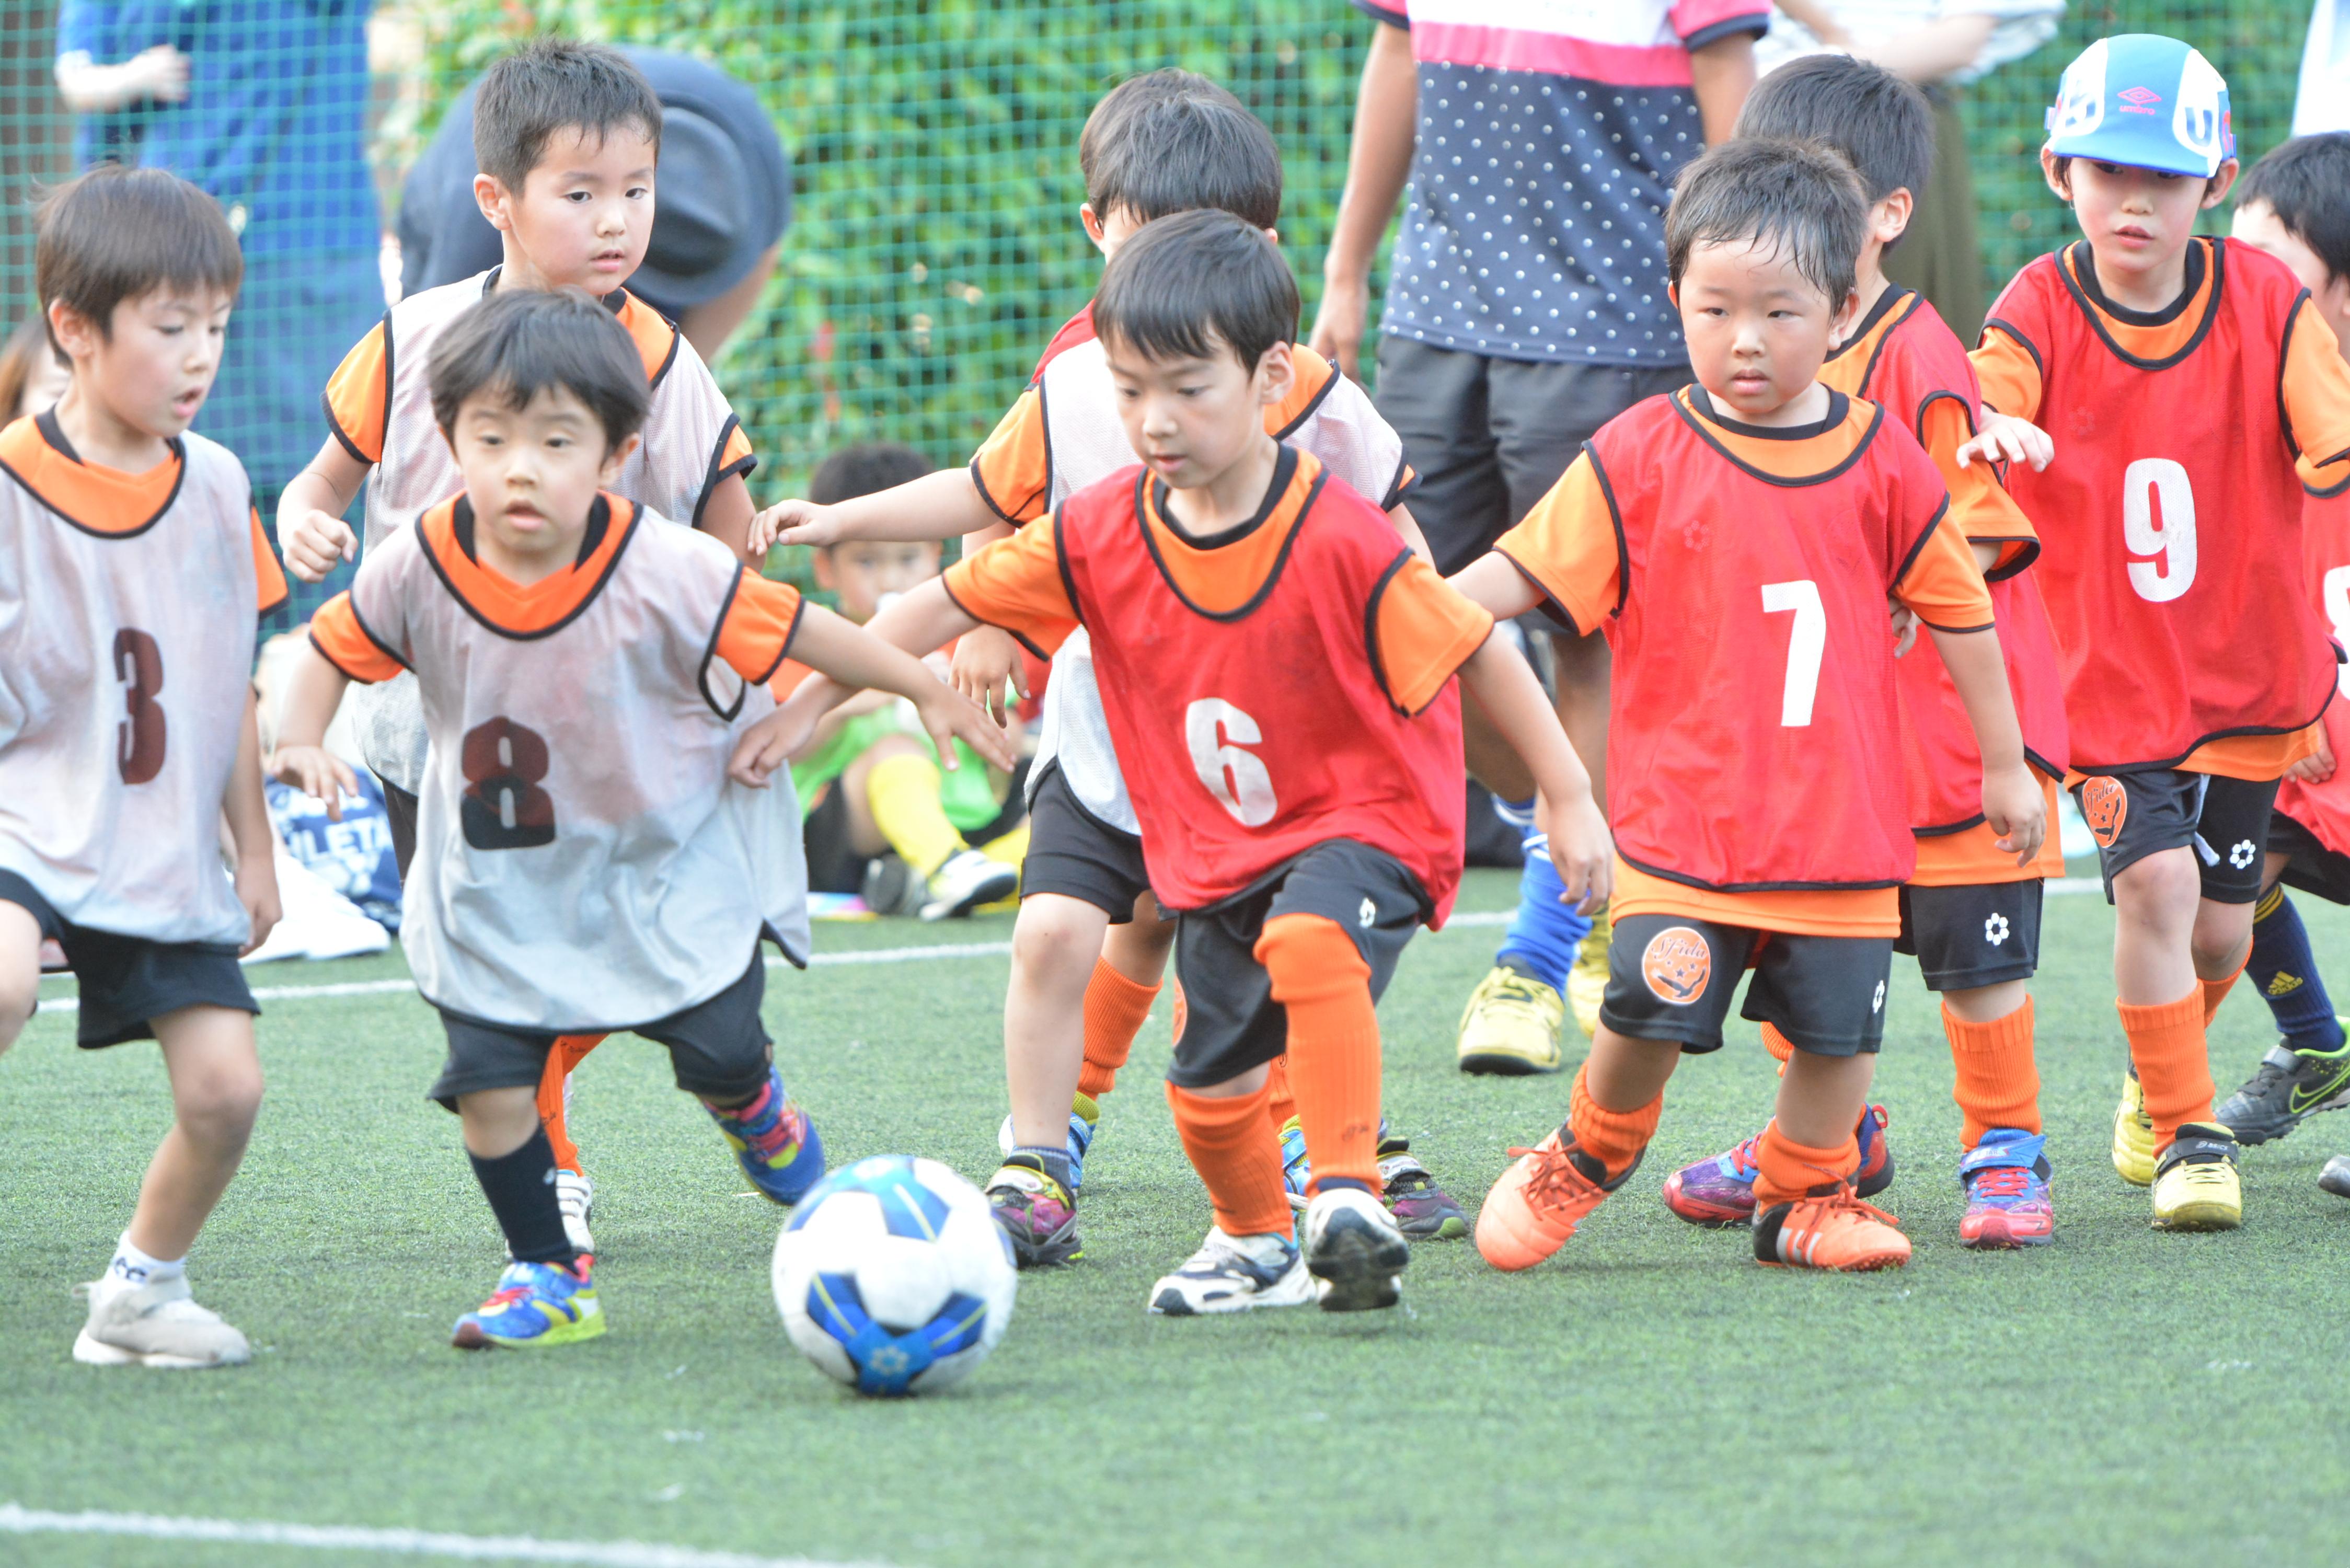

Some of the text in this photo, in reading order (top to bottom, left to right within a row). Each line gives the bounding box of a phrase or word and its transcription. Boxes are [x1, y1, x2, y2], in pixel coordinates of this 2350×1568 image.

[2119, 104, 2156, 115] umbro
[2124, 458, 2197, 602] 9
[113, 627, 166, 785] 3
[1761, 580, 1826, 727] 7
[461, 716, 556, 850] 8
[1186, 697, 1277, 827] 6
[1651, 938, 1707, 962] Sfida
